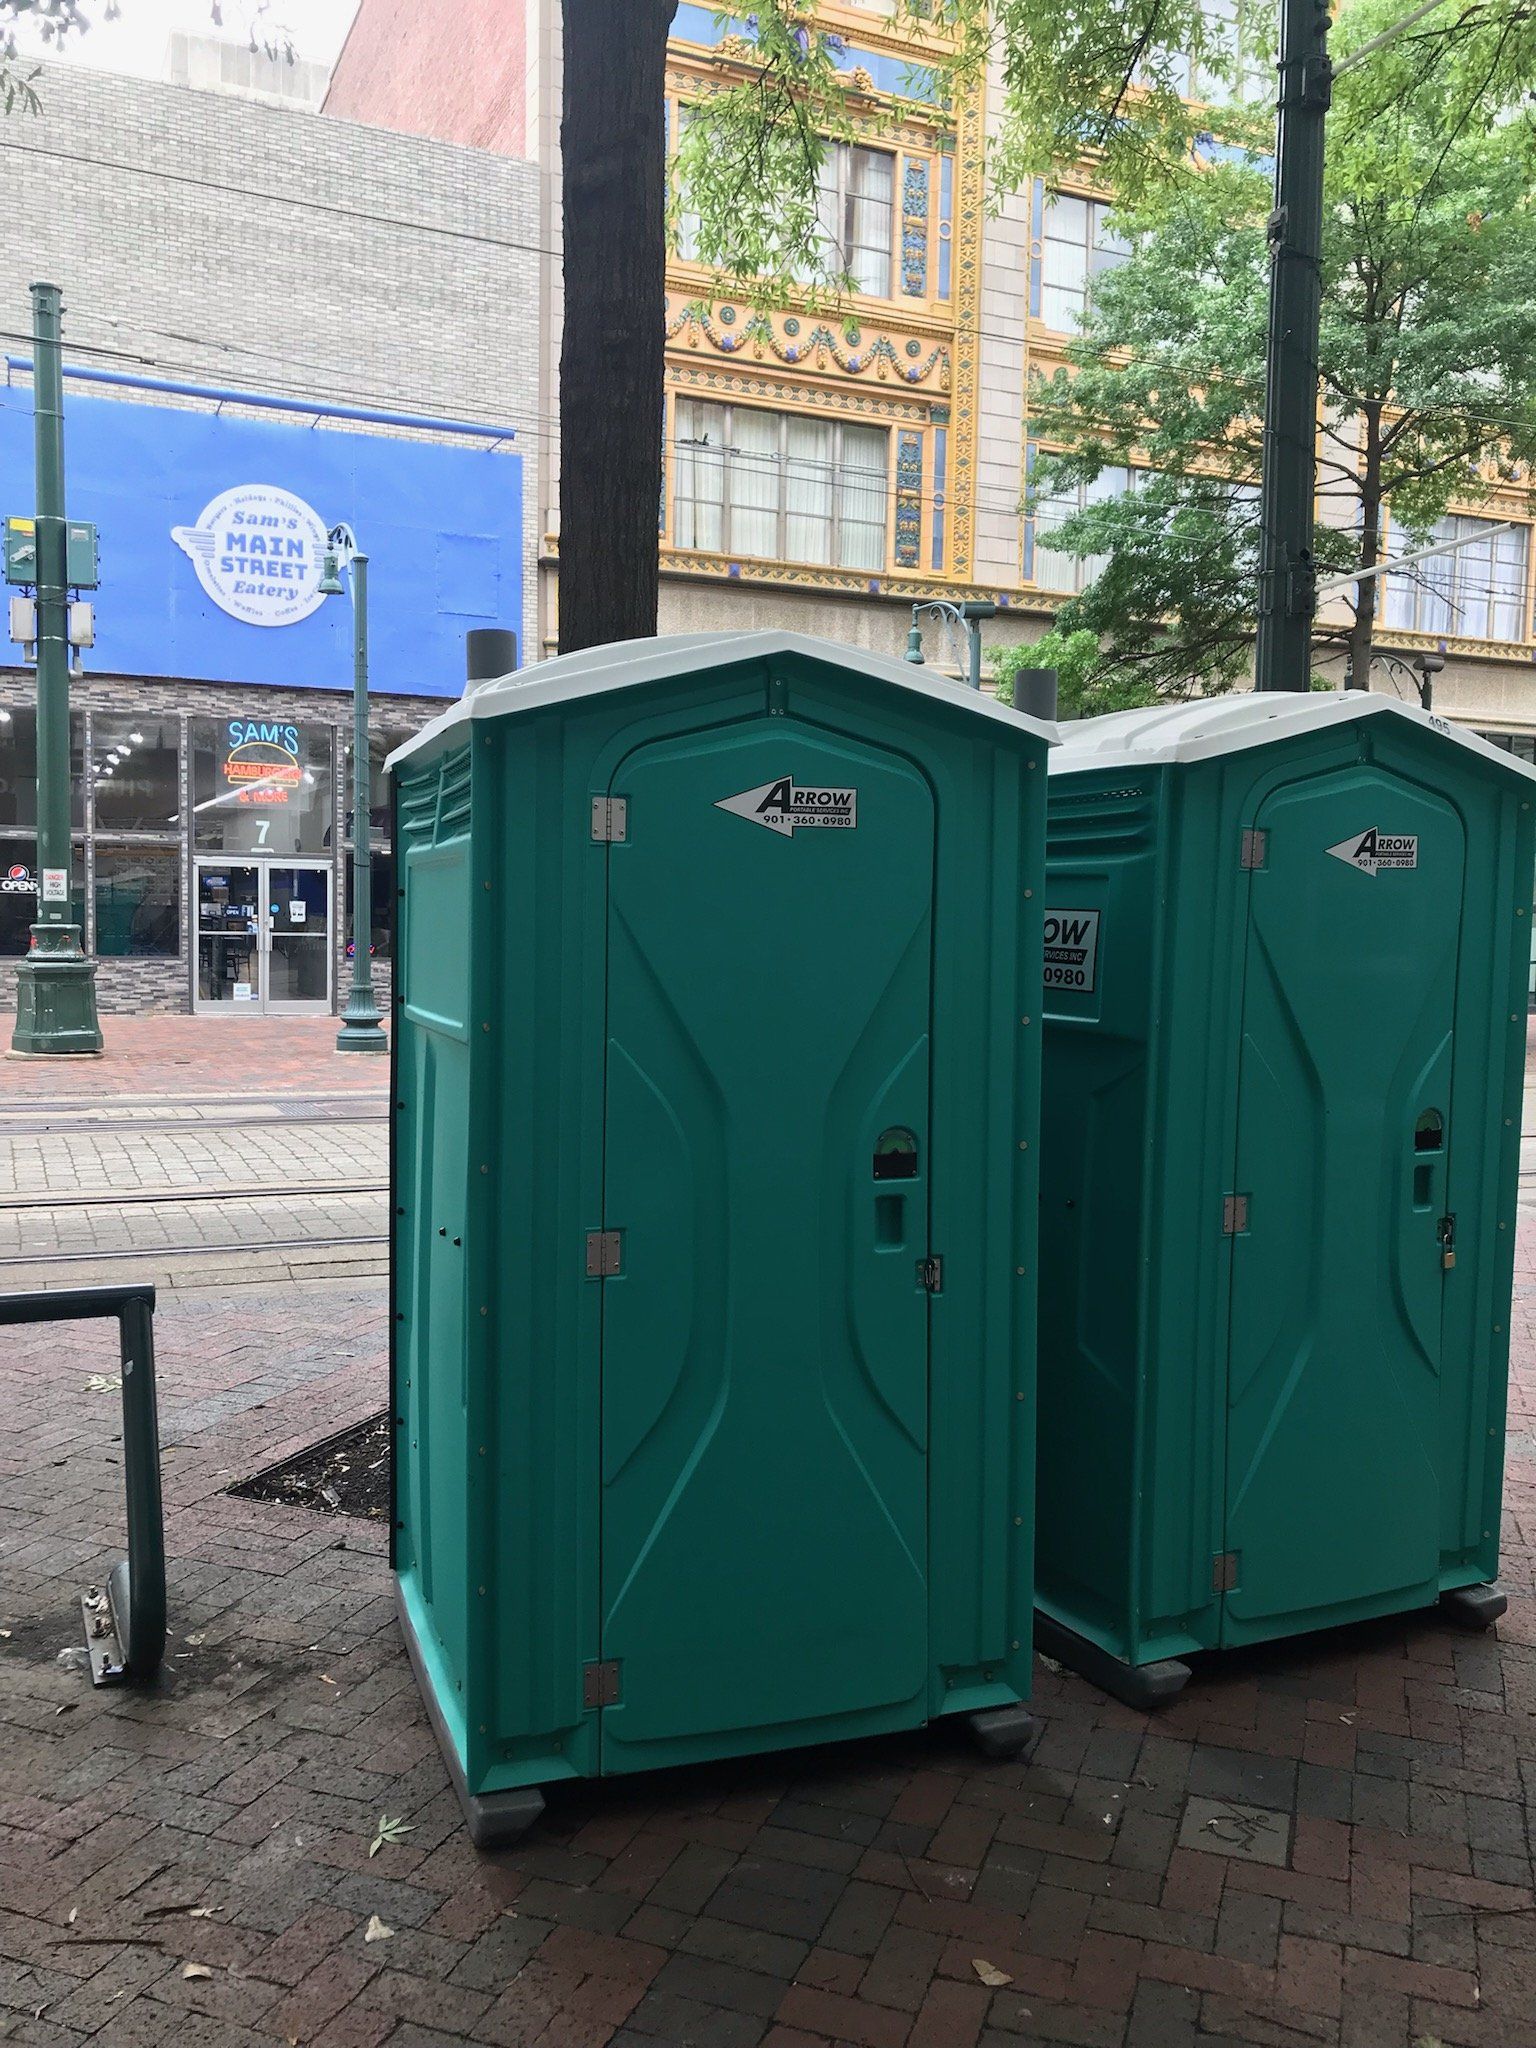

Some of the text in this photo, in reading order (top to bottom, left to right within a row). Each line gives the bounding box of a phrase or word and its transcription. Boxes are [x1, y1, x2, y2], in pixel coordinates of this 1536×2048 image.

[232, 510, 298, 530] Sam's
[226, 532, 304, 558] MAIN
[221, 556, 308, 580] STREET
[232, 580, 299, 601] Eatery
[229, 721, 299, 755] SAM'S
[240, 789, 288, 803] & MORE
[755, 779, 852, 814] ARROW
[256, 820, 270, 844] 7
[1352, 829, 1415, 858] ARROW
[1, 880, 38, 891] OPEN
[226, 908, 240, 916] OPEN
